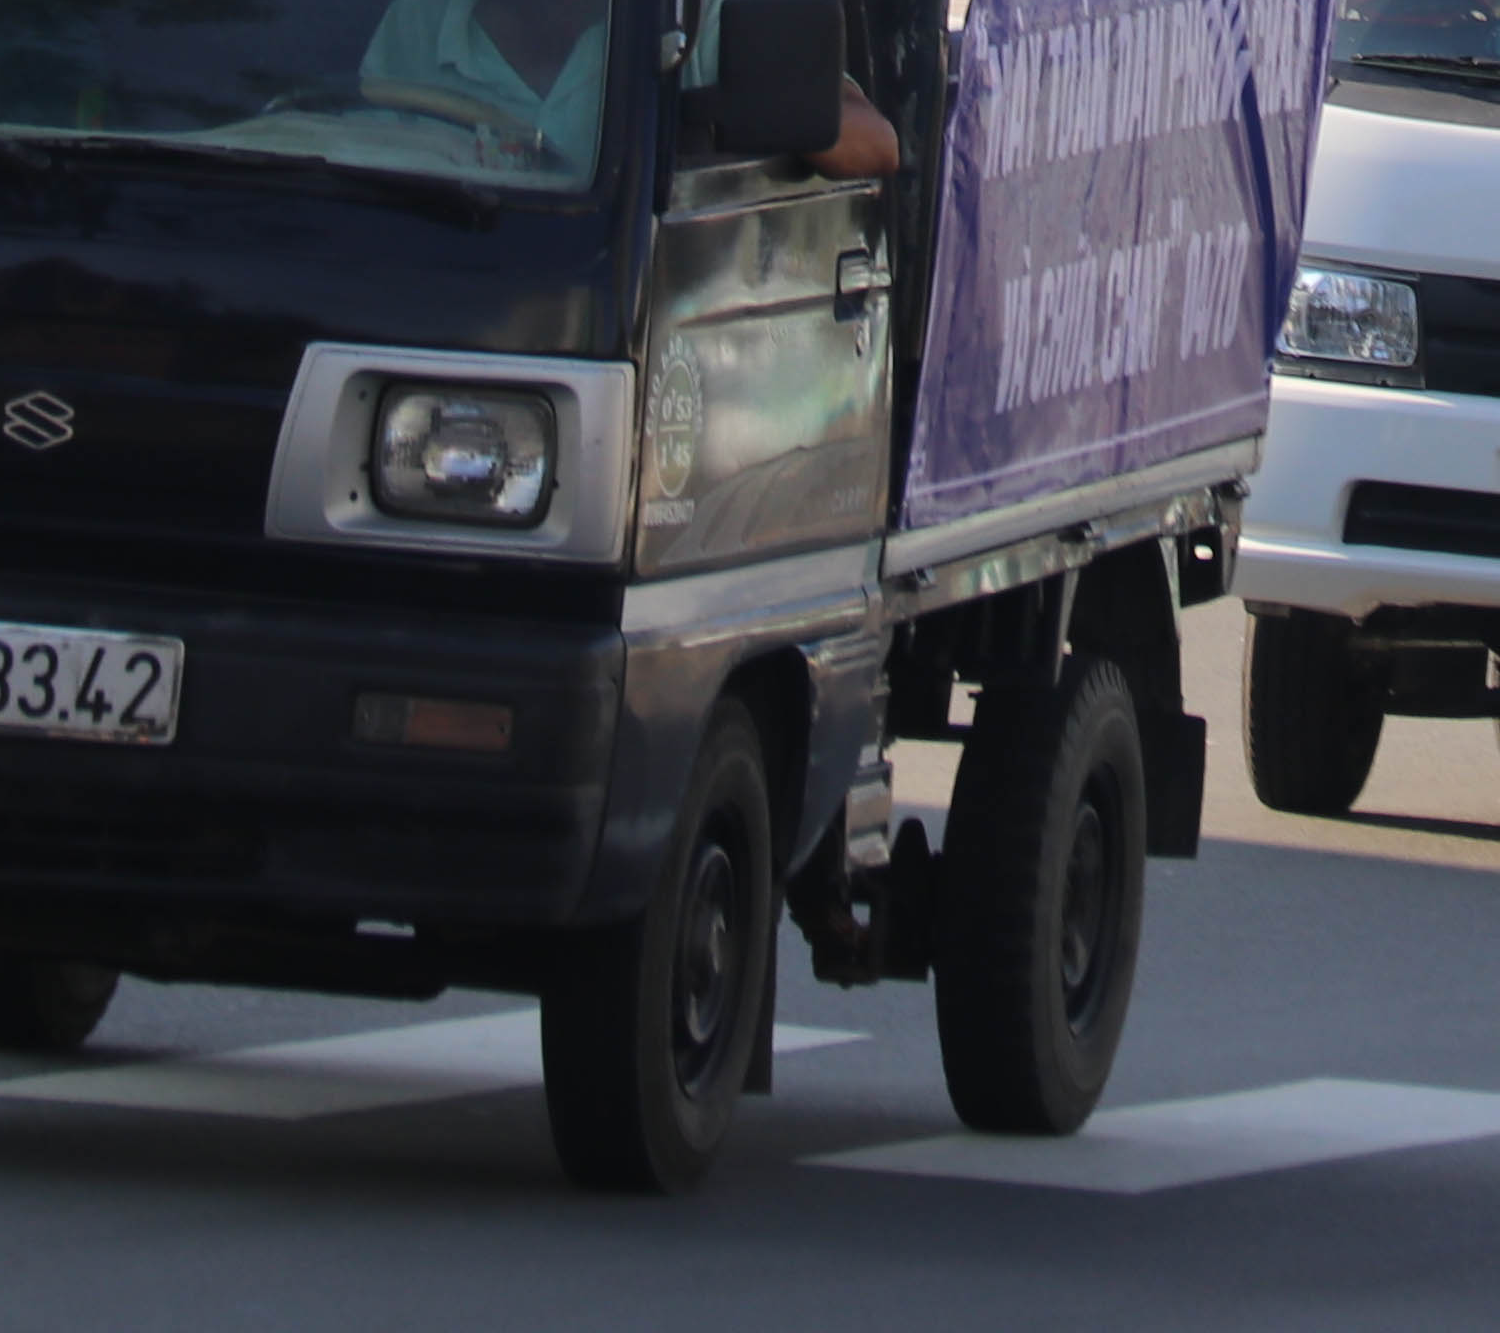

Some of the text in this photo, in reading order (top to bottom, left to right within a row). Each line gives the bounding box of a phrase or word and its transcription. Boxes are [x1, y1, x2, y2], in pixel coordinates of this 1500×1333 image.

[995, 245, 1033, 414] VÀ
[1030, 234, 1100, 406] CHỮA
[1181, 219, 1252, 361] 04/10
